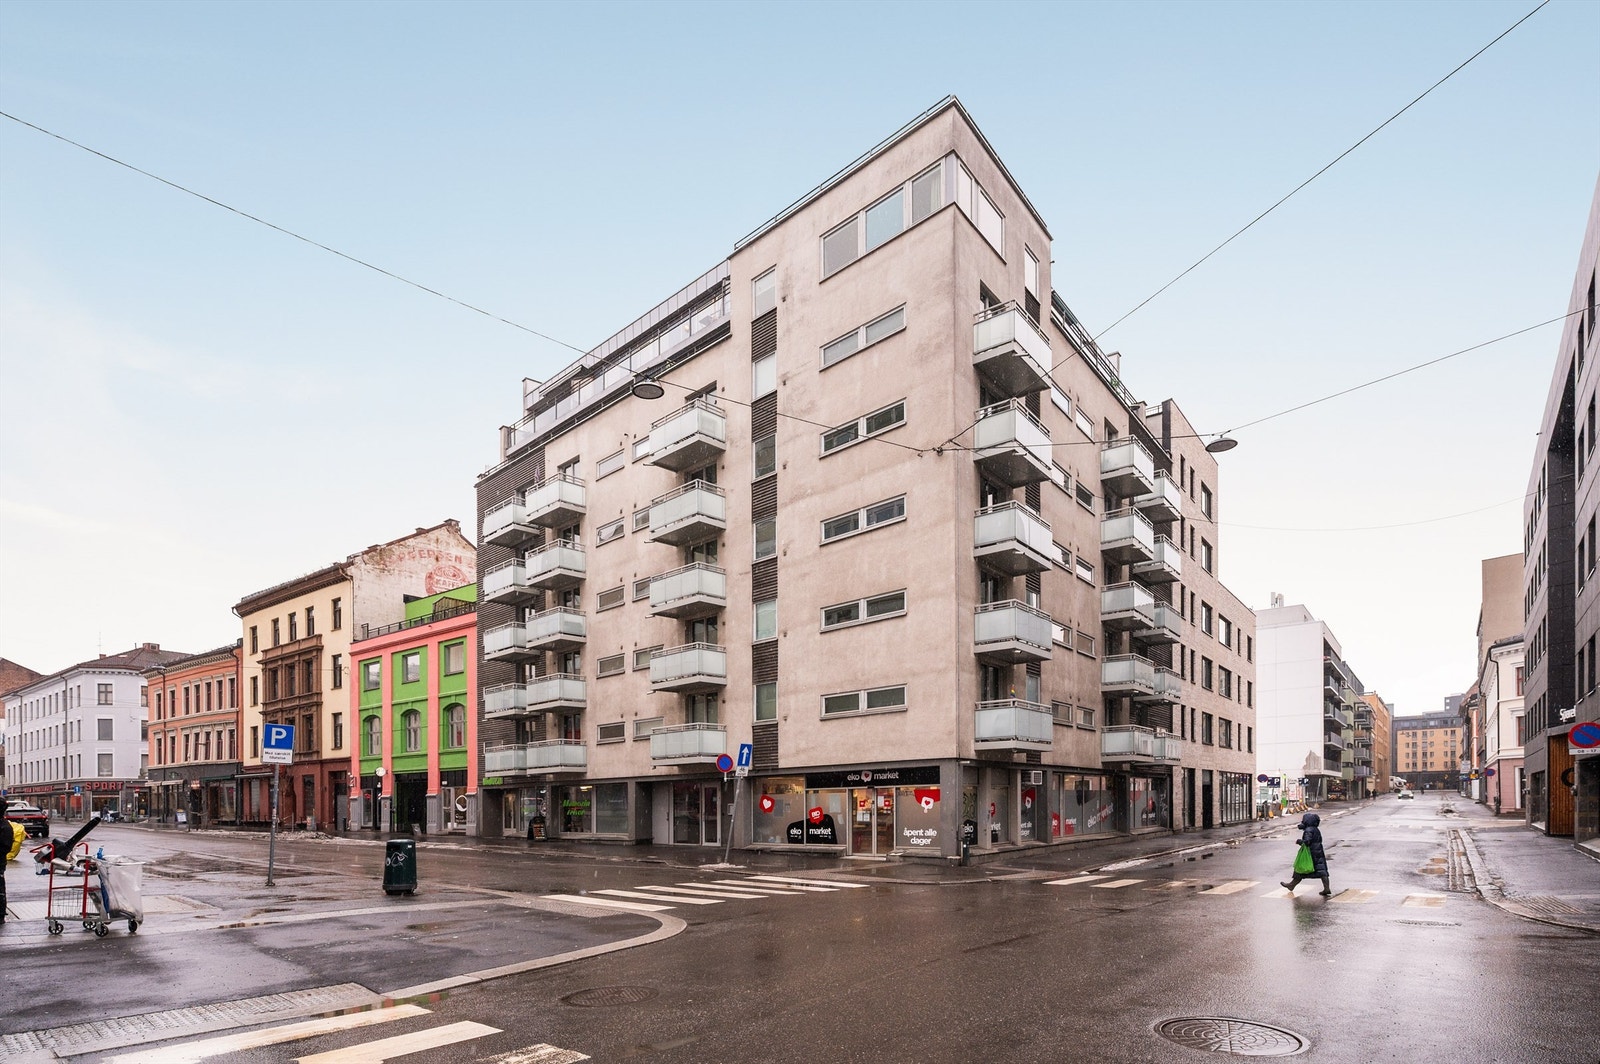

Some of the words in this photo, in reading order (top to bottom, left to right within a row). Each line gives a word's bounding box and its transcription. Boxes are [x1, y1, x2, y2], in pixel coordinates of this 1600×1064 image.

[271, 727, 287, 746] P
[847, 773, 860, 781] eko
[873, 771, 899, 780] market
[85, 781, 124, 791] SPORT
[790, 827, 802, 835] eko
[809, 827, 831, 835] market
[903, 827, 923, 837] åpent
[924, 828, 937, 837] alle
[910, 837, 932, 846] dager
